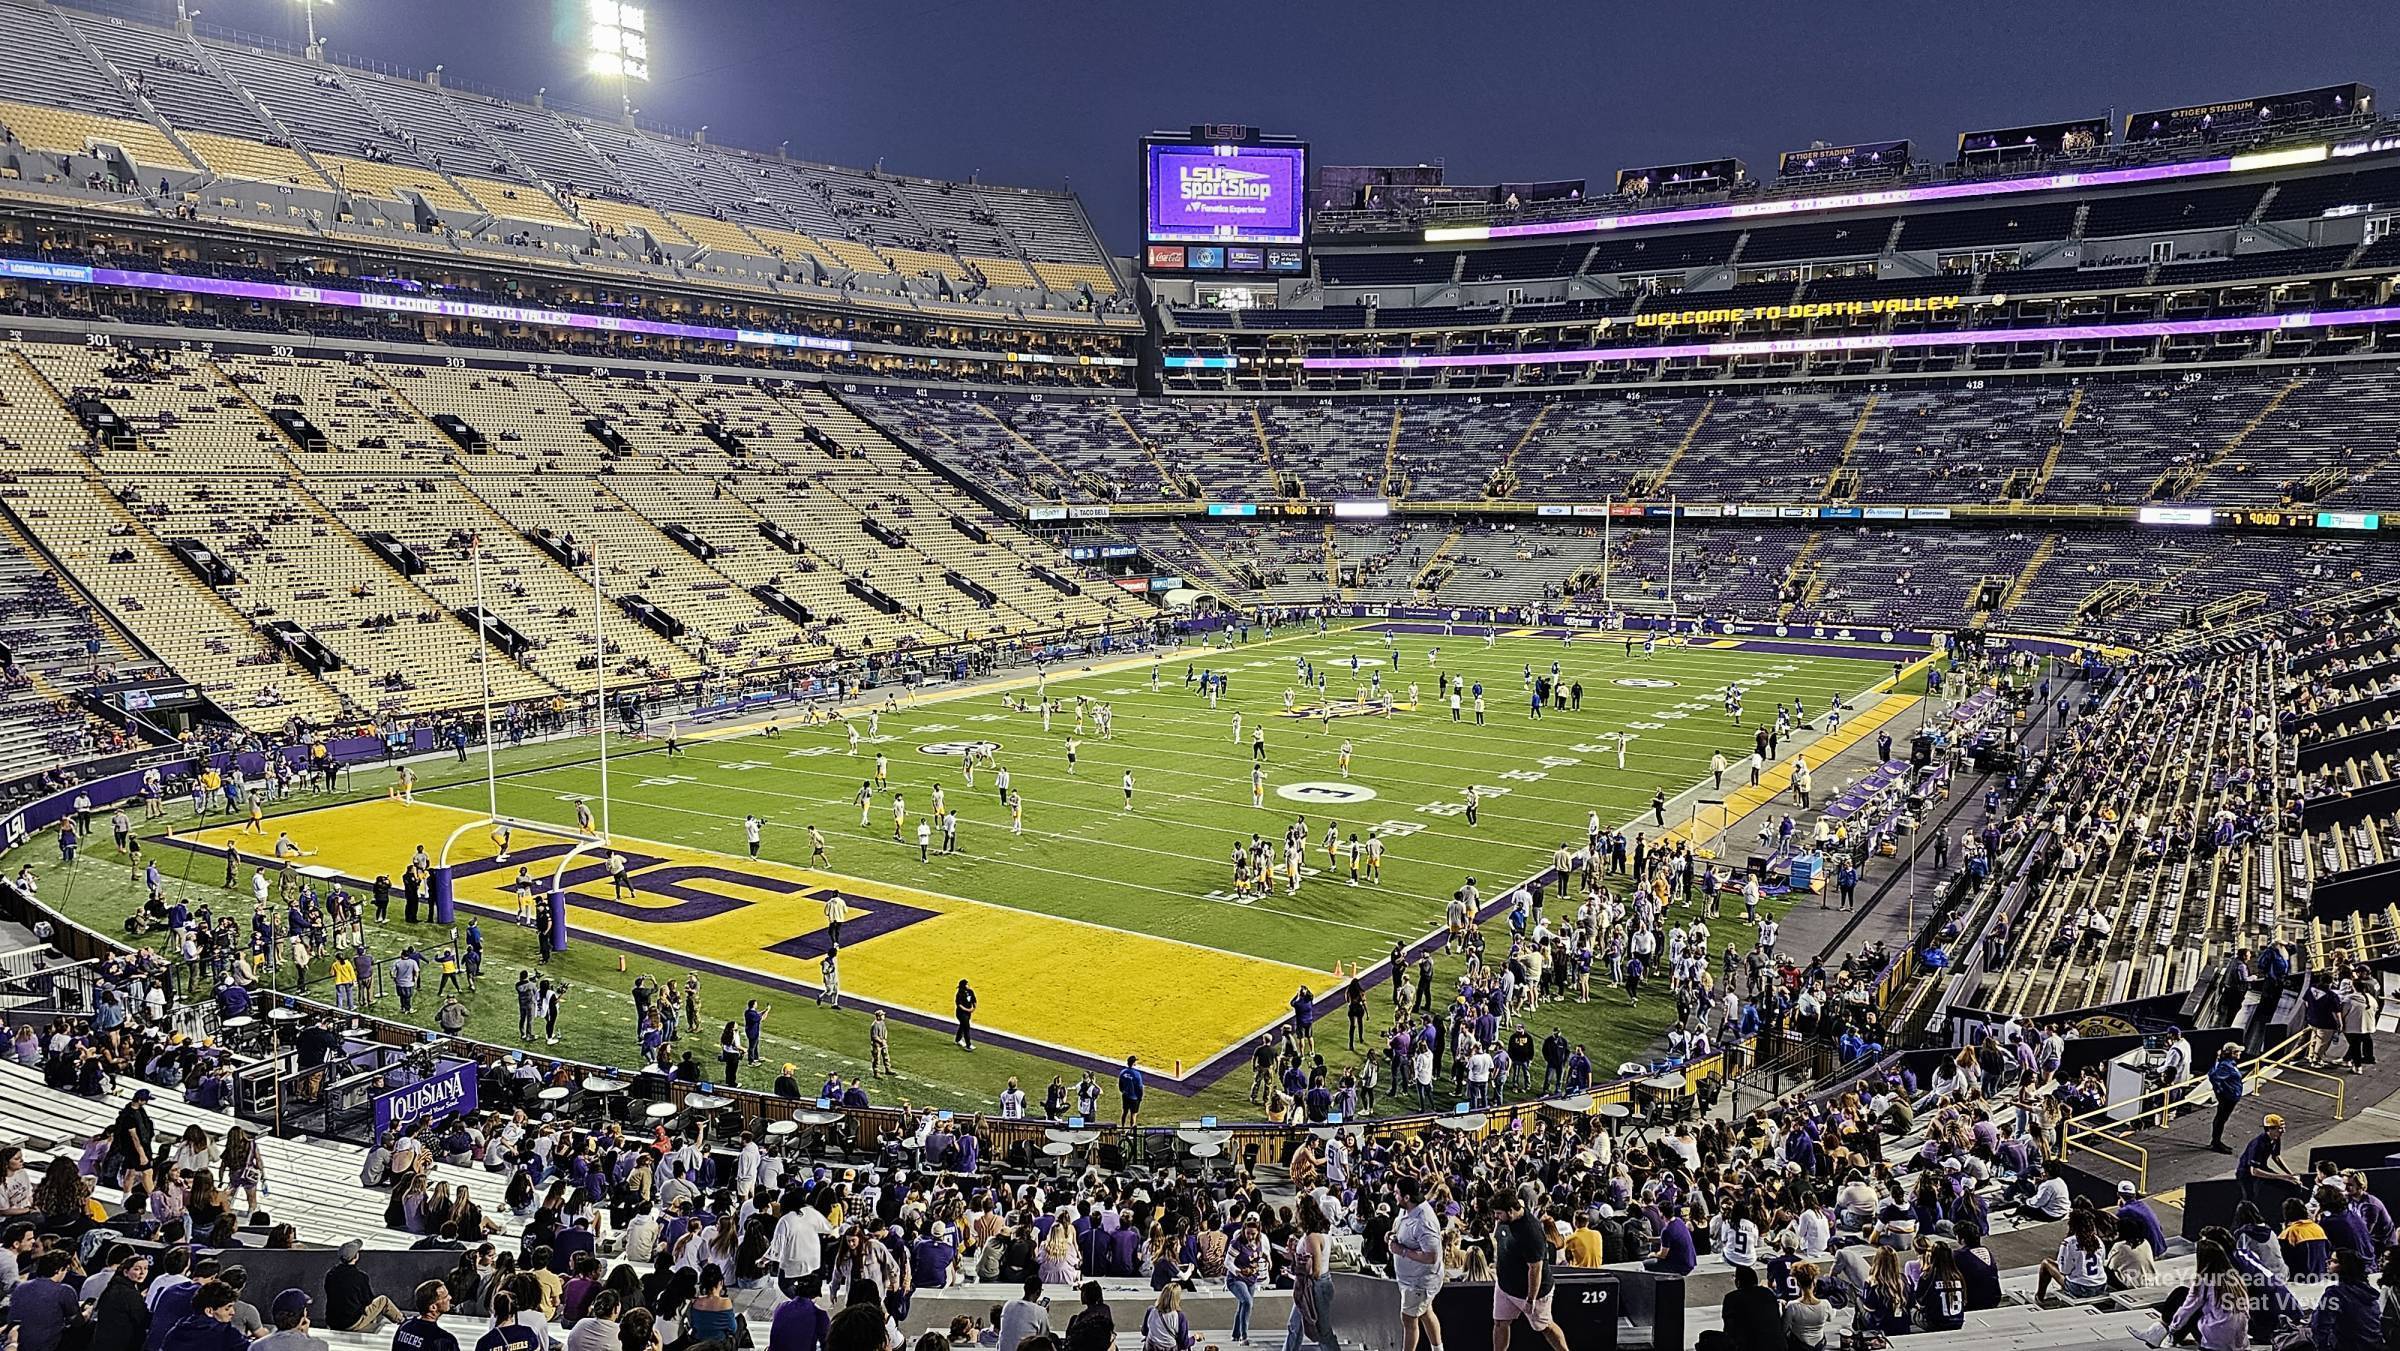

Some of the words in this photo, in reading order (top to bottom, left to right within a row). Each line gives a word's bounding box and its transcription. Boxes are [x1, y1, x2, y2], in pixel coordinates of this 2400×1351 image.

[2179, 108, 2207, 118] TIGER
[2209, 101, 2253, 114] STADIUM
[1205, 123, 1247, 140] LSU
[1795, 152, 1818, 160] TIGER
[1820, 148, 1855, 158] STADIUM
[1180, 167, 1222, 182] LSU
[1230, 204, 1266, 214] Experience
[10, 264, 52, 276] LOUISIANA
[52, 267, 85, 278] LOTTERY
[291, 288, 320, 302] LSU
[360, 294, 441, 314] WELCOME
[447, 302, 464, 315] TO
[468, 304, 516, 319] DEATH
[519, 308, 571, 324] VALLEY
[1636, 308, 1745, 327] WELCOME
[1753, 306, 1781, 320] TO
[1788, 301, 1862, 318] DEATH
[1872, 296, 1959, 314] VALLEY
[597, 317, 619, 329] LSU
[86, 334, 112, 346] 301
[271, 346, 295, 358] 302
[446, 358, 466, 368] 303
[699, 374, 714, 383] 305
[2182, 373, 2202, 382] 419
[781, 380, 795, 388] 306
[844, 384, 856, 392] 410
[1966, 380, 1984, 390] 418
[916, 389, 928, 397] 411
[1626, 392, 1640, 400] 416
[1782, 387, 1796, 395] 417
[1030, 394, 1042, 402] 412
[2250, 512, 2280, 525] 90:00
[1110, 548, 1137, 556] Marathon
[1365, 607, 1389, 617] LSU
[151, 692, 184, 700] POWERADE
[1414, 801, 1470, 817] 25
[6, 812, 26, 844] LSU
[452, 843, 944, 960] LSU
[389, 1071, 465, 1124] LOUISIANA
[1327, 1150, 1336, 1166] 9
[1735, 1232, 1748, 1254] 9
[2086, 1254, 2098, 1276] 2
[1786, 1277, 1800, 1297] 9
[1582, 1290, 1608, 1304] 219
[1939, 1290, 1963, 1317] 18
[398, 1330, 425, 1349] TIGERS
[507, 1340, 529, 1351] TIGERS
